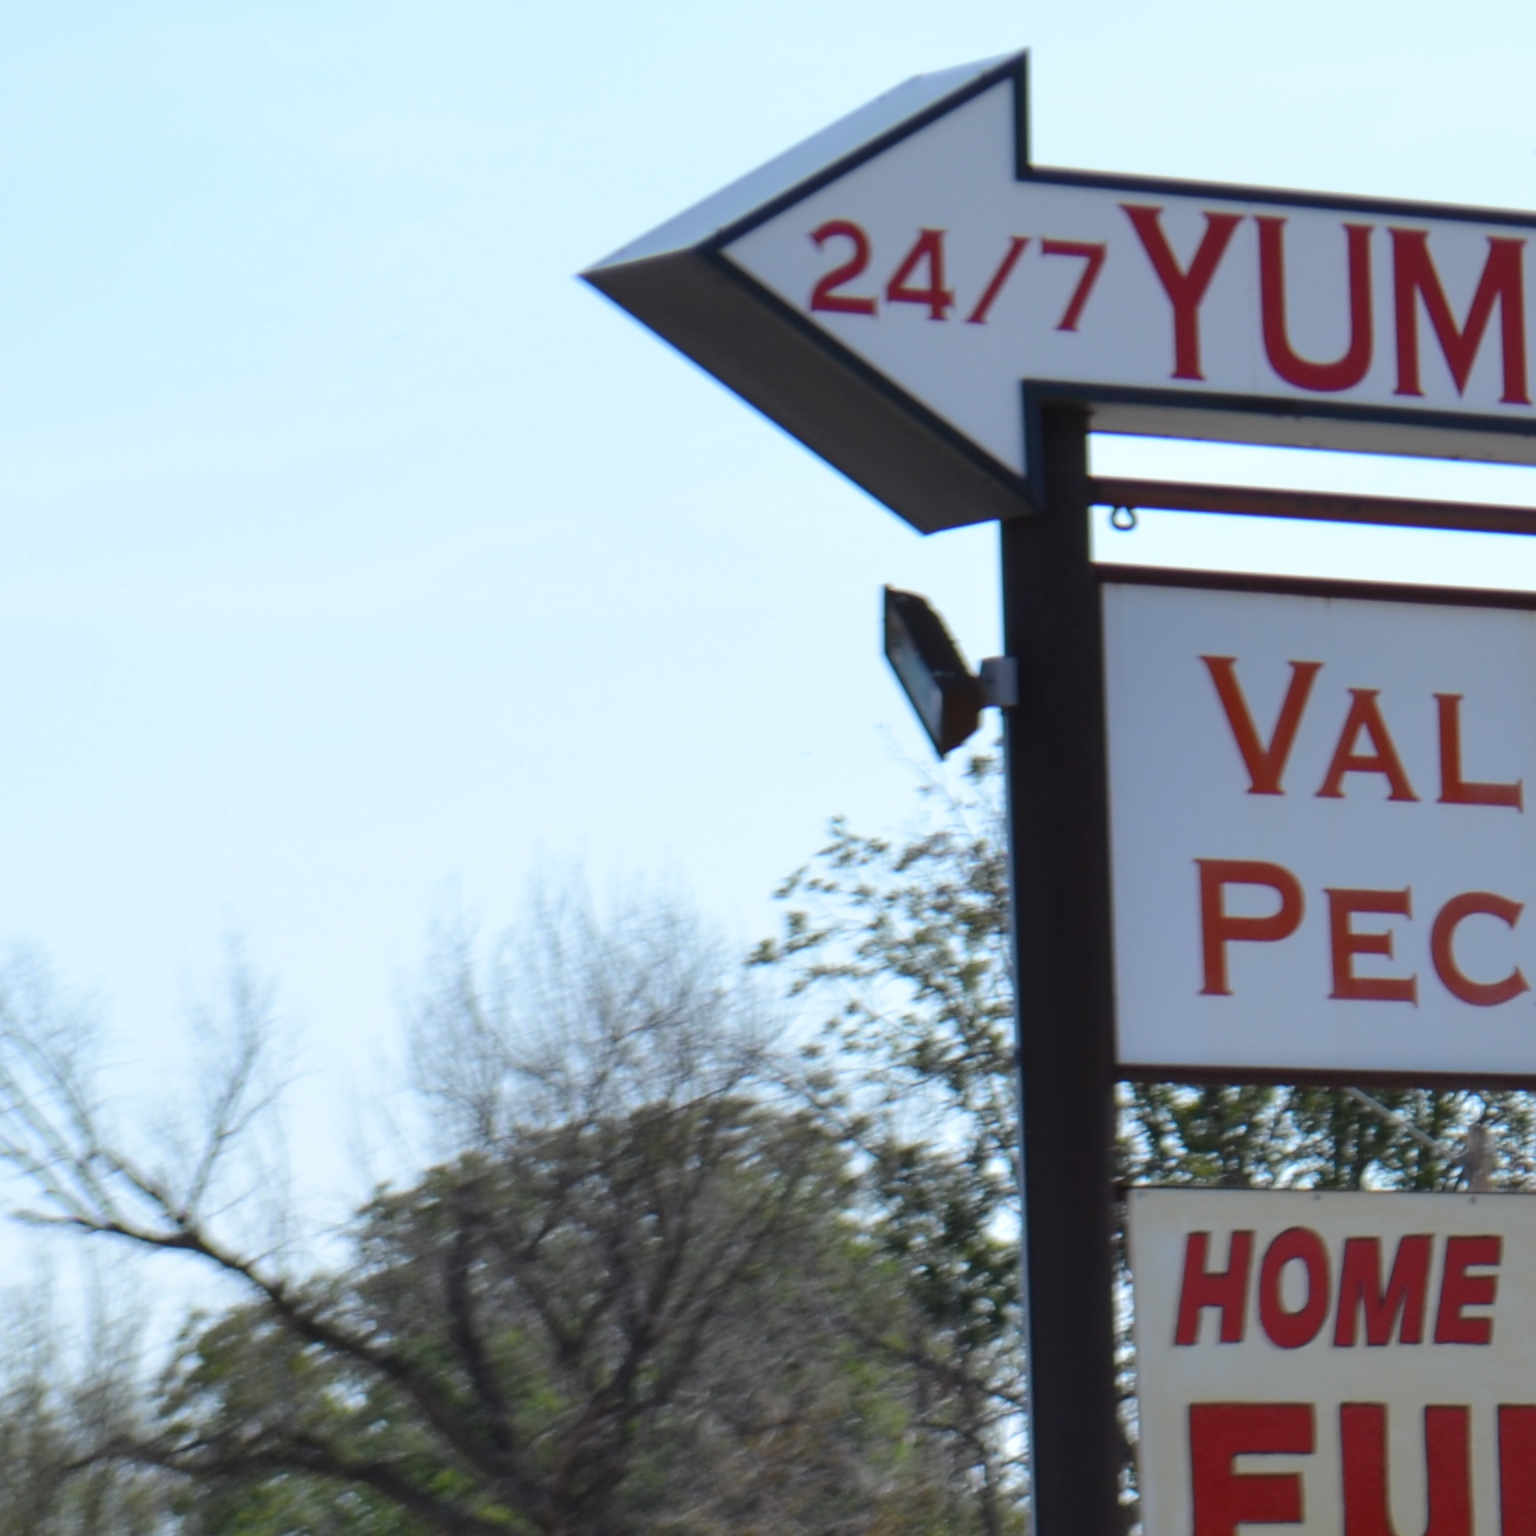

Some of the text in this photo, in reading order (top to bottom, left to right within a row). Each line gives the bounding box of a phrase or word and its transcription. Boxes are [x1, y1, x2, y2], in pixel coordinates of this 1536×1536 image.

[806, 219, 1109, 332] 24/7
[1118, 203, 1533, 406] YUM
[1174, 1226, 1503, 1350] HOME
